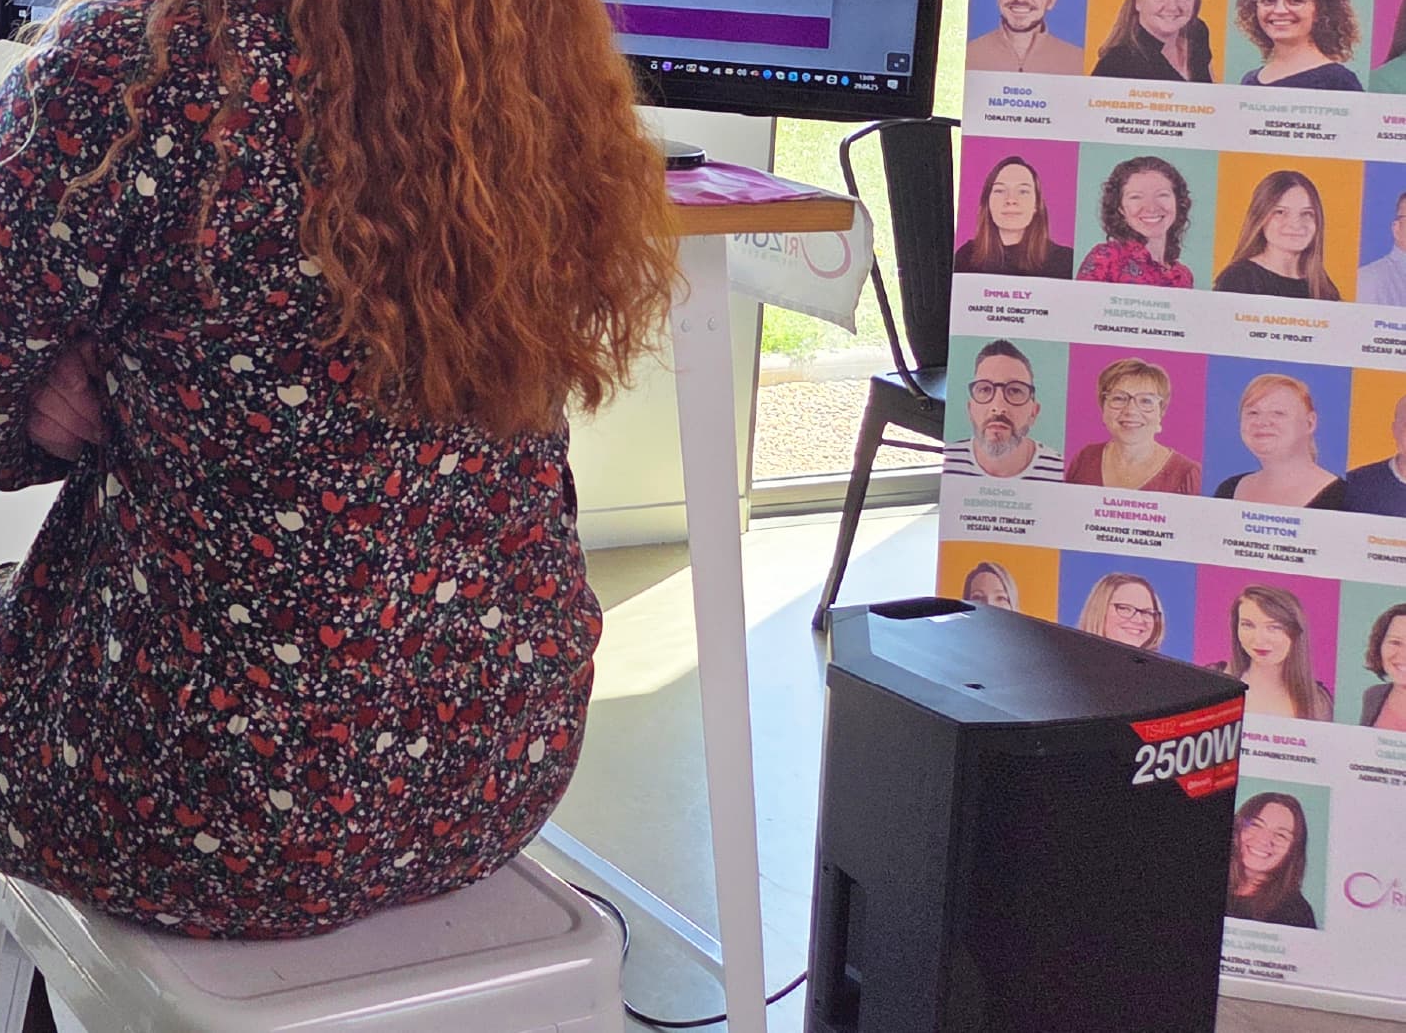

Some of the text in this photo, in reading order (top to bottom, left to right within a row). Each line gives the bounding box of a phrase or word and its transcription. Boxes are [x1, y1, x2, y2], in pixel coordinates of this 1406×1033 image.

[988, 97, 1047, 109] NAPODANO
[1012, 290, 1032, 300] ELY
[1283, 333, 1314, 343] PROJET
[1242, 731, 1269, 742] MIRA
[1132, 720, 1241, 785] 2500W
